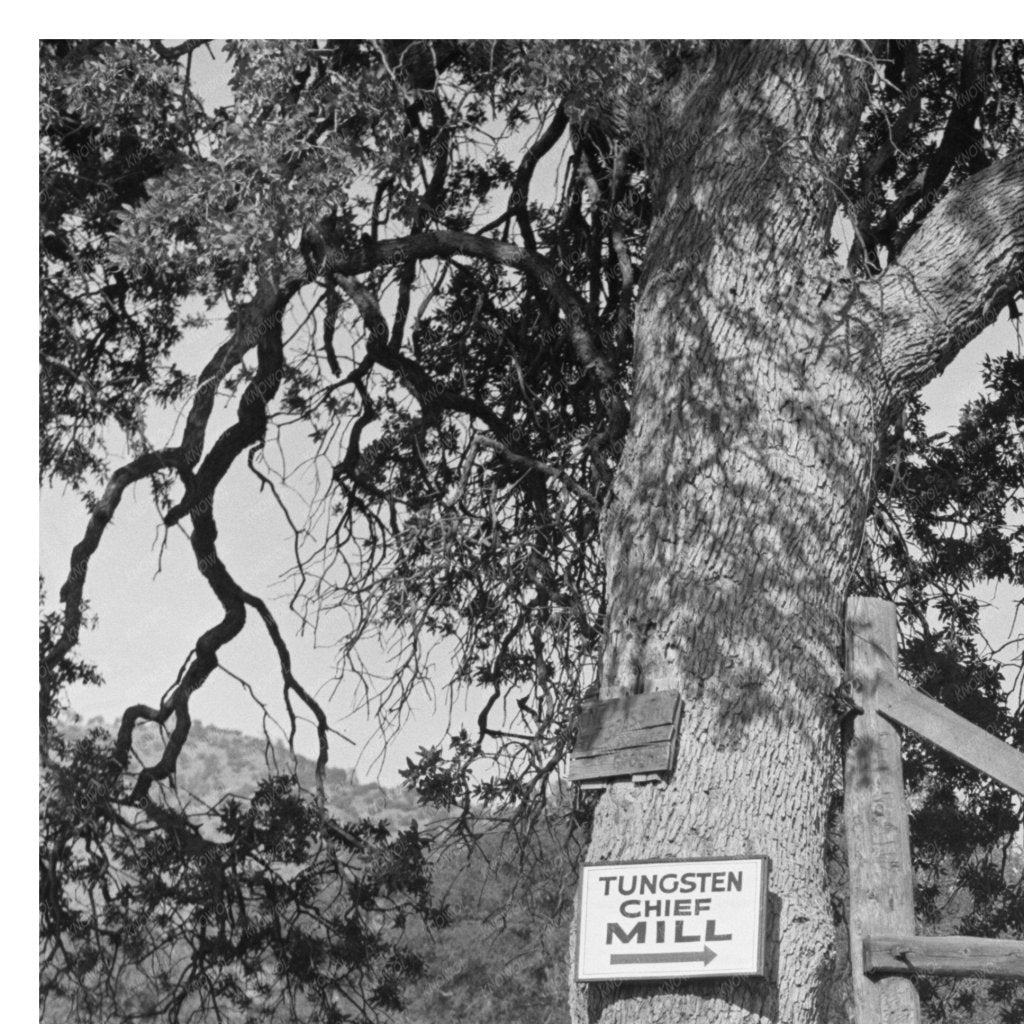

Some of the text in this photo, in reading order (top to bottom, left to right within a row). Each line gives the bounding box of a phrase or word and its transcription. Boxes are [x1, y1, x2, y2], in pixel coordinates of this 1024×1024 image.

[598, 871, 743, 896] TUNGSTEN
[619, 898, 712, 918] CHIEF
[605, 919, 733, 945] MILL
